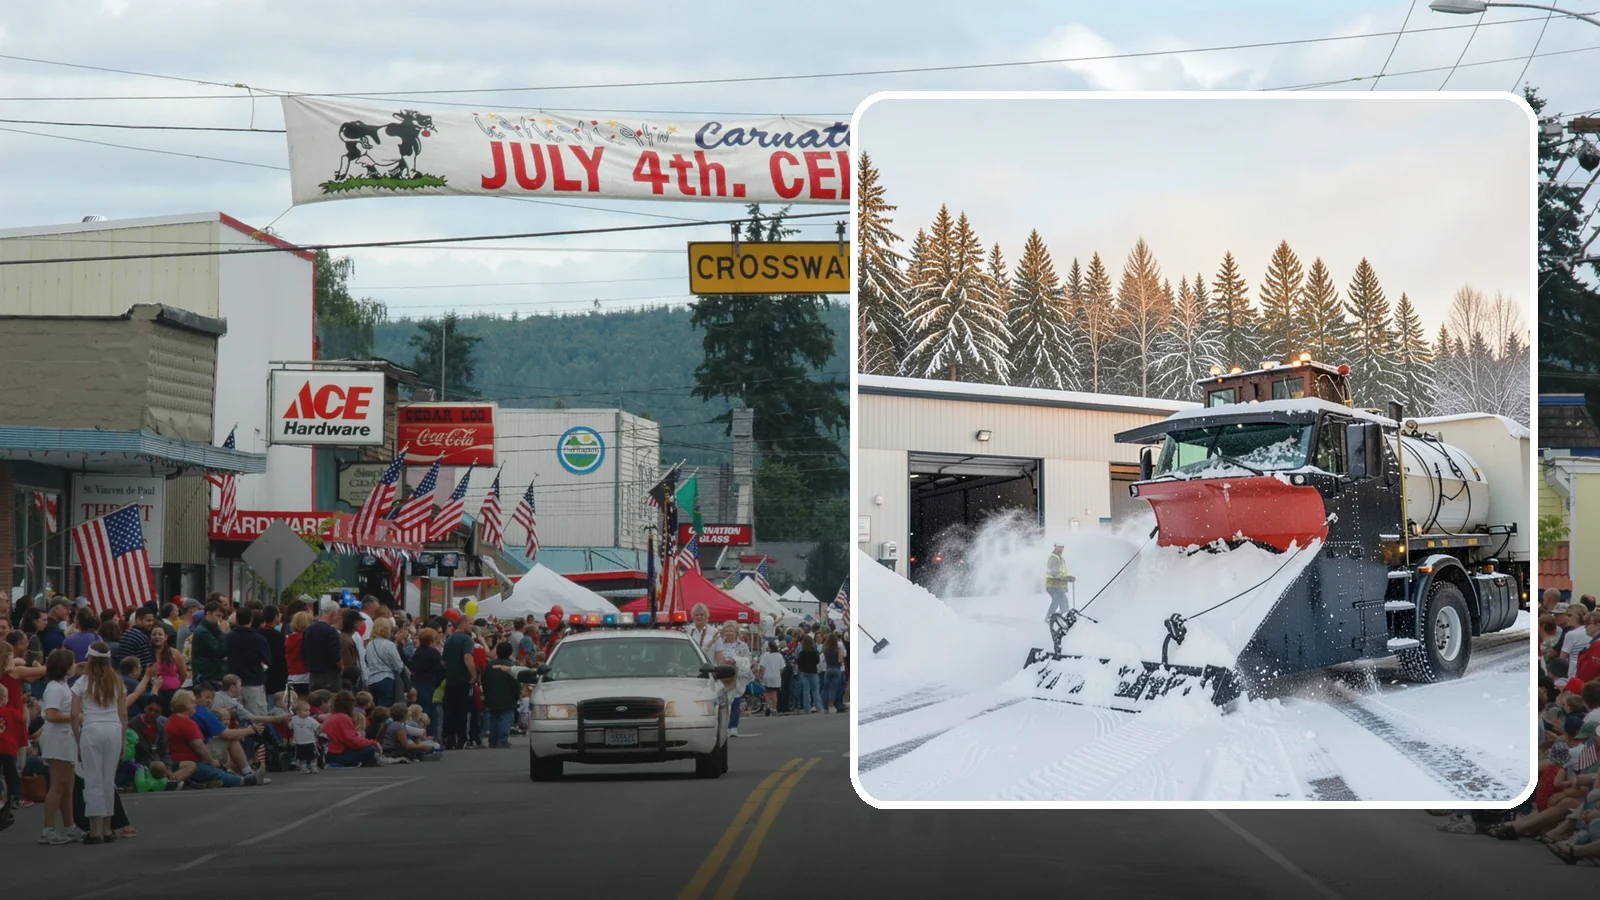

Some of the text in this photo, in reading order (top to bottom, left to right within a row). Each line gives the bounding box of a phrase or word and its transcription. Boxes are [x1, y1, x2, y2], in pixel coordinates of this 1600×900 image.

[695, 121, 850, 149] Carnat
[481, 141, 605, 192] JULY
[632, 150, 746, 198] 4th.
[697, 254, 850, 280] CROSSWA
[282, 380, 374, 420] ACE
[405, 409, 452, 422] CEDAR
[283, 421, 371, 436] Hardware
[95, 485, 124, 495] Vincent
[126, 486, 136, 495] de
[137, 486, 155, 495] Paul
[212, 516, 331, 536] HARDARE
[688, 526, 741, 535] CRNATION
[699, 535, 730, 543] GLASS
